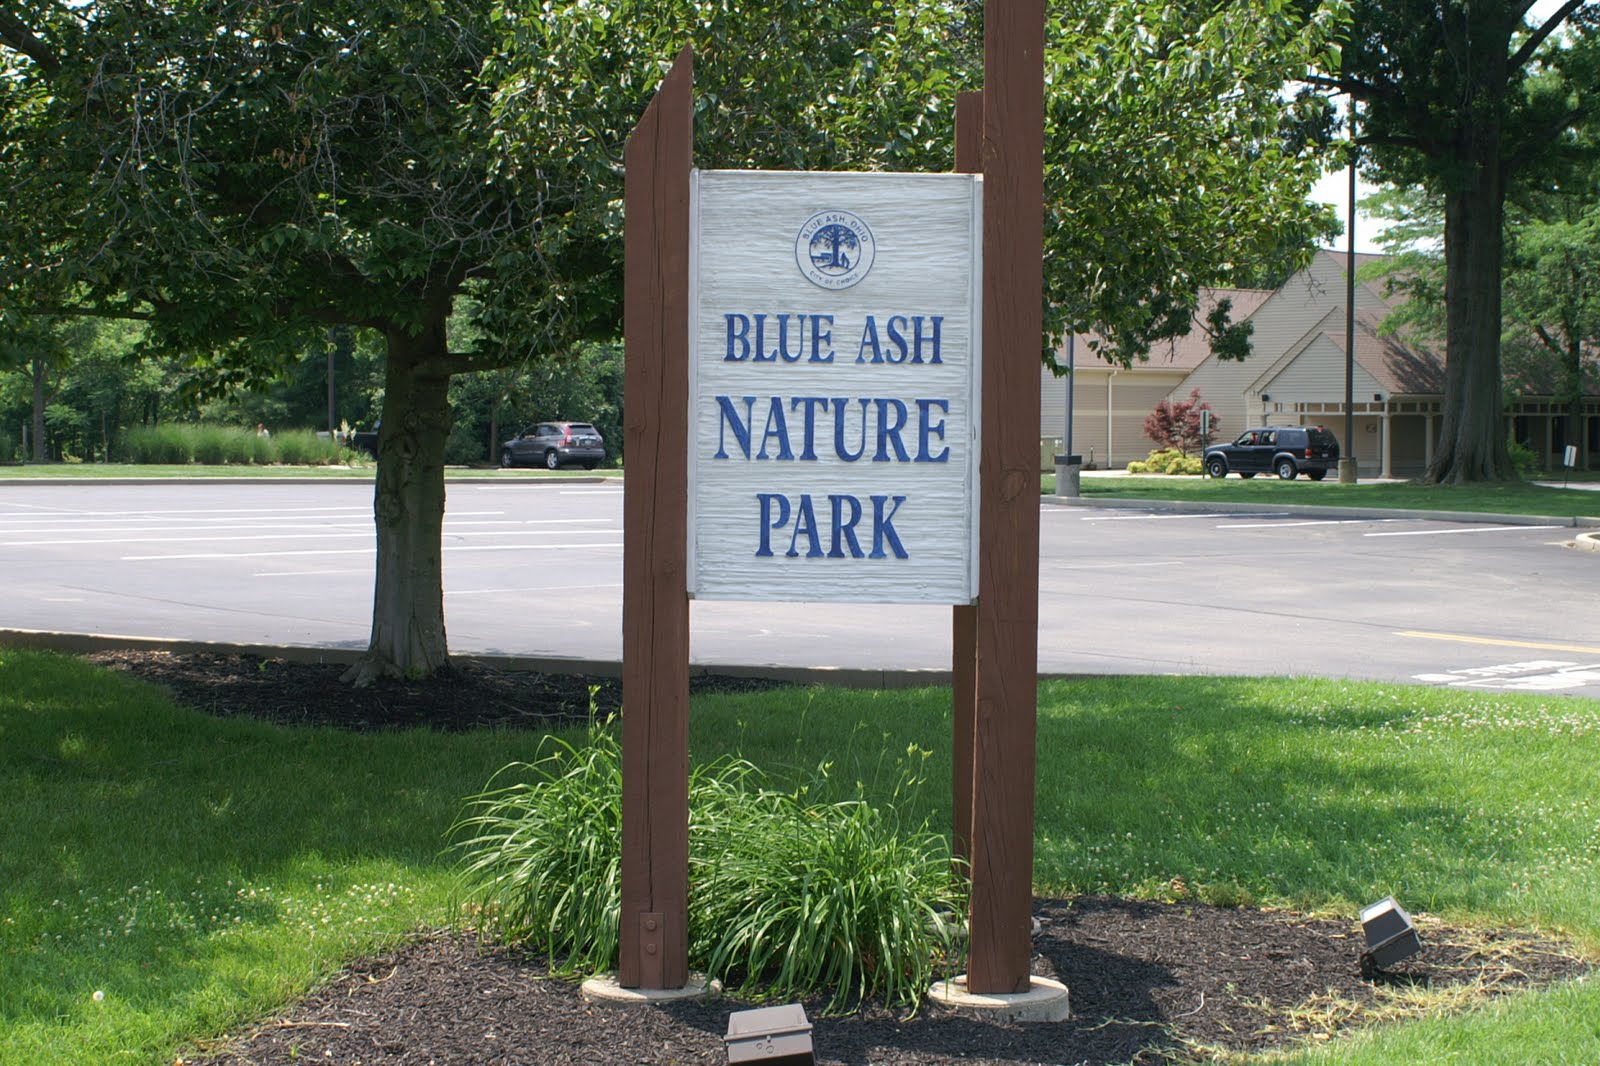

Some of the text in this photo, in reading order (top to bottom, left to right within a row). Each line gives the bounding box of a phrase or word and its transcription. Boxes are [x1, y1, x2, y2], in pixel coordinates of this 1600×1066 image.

[803, 218, 825, 240] BLUE
[850, 220, 869, 243] OHIO
[723, 313, 945, 364] BLUE ASH
[714, 395, 950, 463] NATURE
[755, 493, 910, 560] PARK
